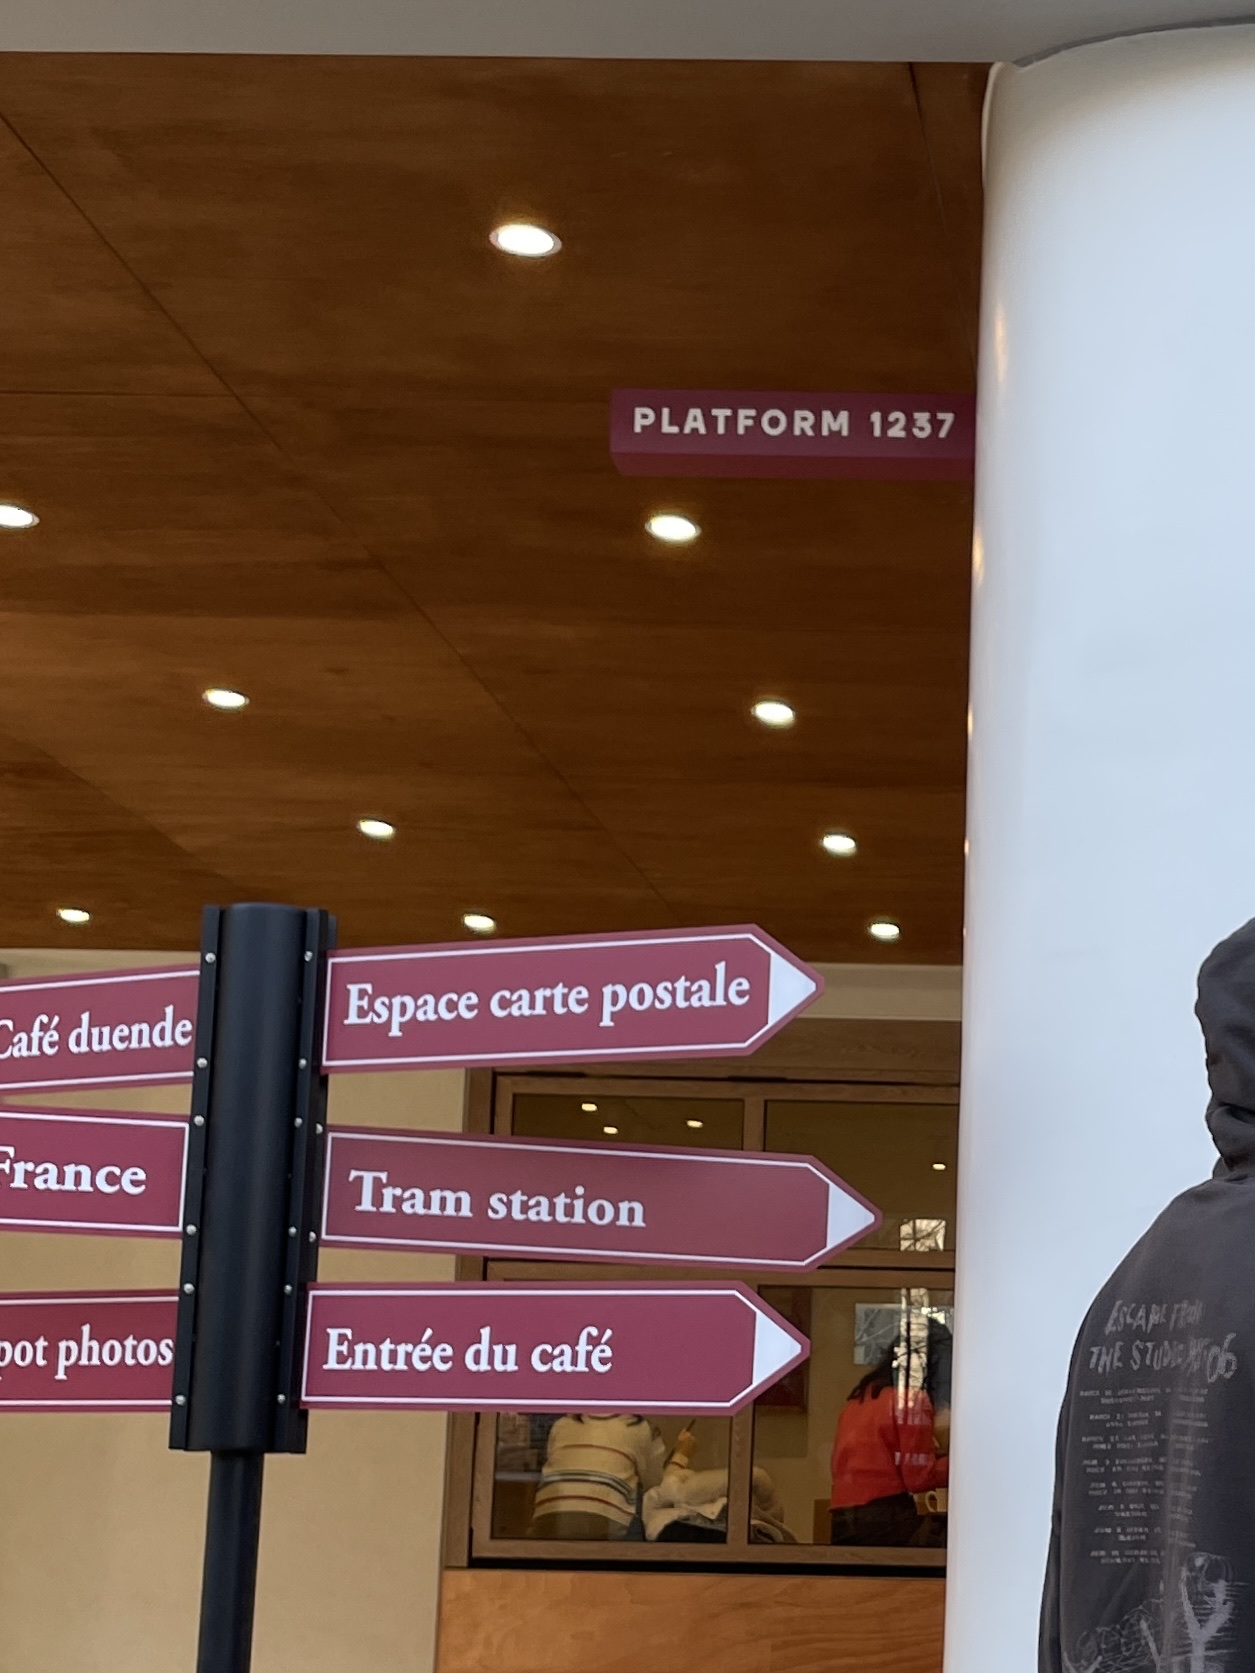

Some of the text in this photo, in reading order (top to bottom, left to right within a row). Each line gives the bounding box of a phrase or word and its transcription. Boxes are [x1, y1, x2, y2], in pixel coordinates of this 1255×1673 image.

[633, 406, 955, 439] PLATFORM 1237
[343, 960, 750, 1037] Espace carte postale
[68, 1004, 193, 1054] duende
[348, 1169, 646, 1227] Tram station
[54, 1323, 174, 1381] photos
[322, 1325, 613, 1373] Entrée du café
[1089, 1340, 1125, 1376] THE
